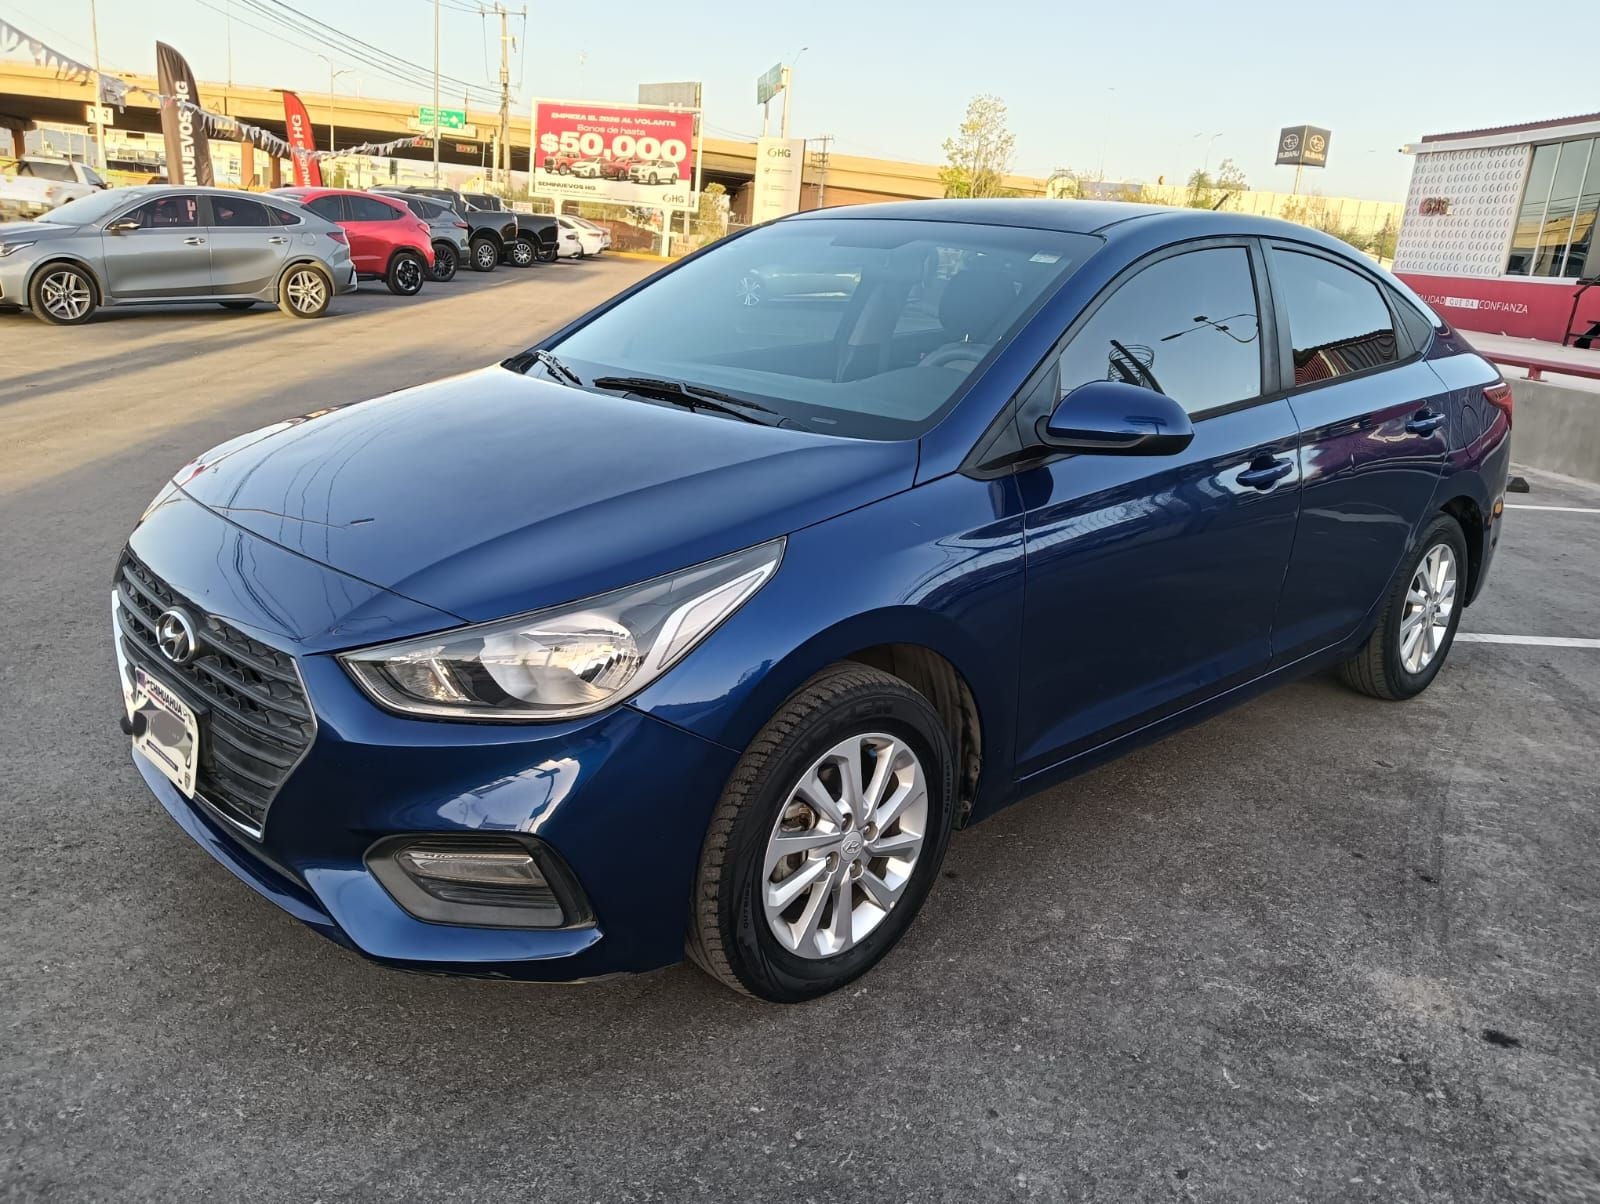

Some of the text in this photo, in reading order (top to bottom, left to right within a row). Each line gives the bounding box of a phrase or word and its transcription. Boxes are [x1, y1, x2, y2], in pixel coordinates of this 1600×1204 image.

[175, 81, 191, 107] HG
[291, 114, 305, 139] HG
[577, 123, 646, 136] Bonos de hasta
[634, 118, 677, 127] VOLANTE
[178, 109, 198, 187] INUEVOS
[540, 131, 687, 163] $50,000
[538, 181, 584, 190] SEMINUEVOS
[1417, 294, 1446, 305] ALIDAD
[1479, 299, 1528, 314] CONFIANZA
[150, 680, 183, 716] CHIHUAHUA
